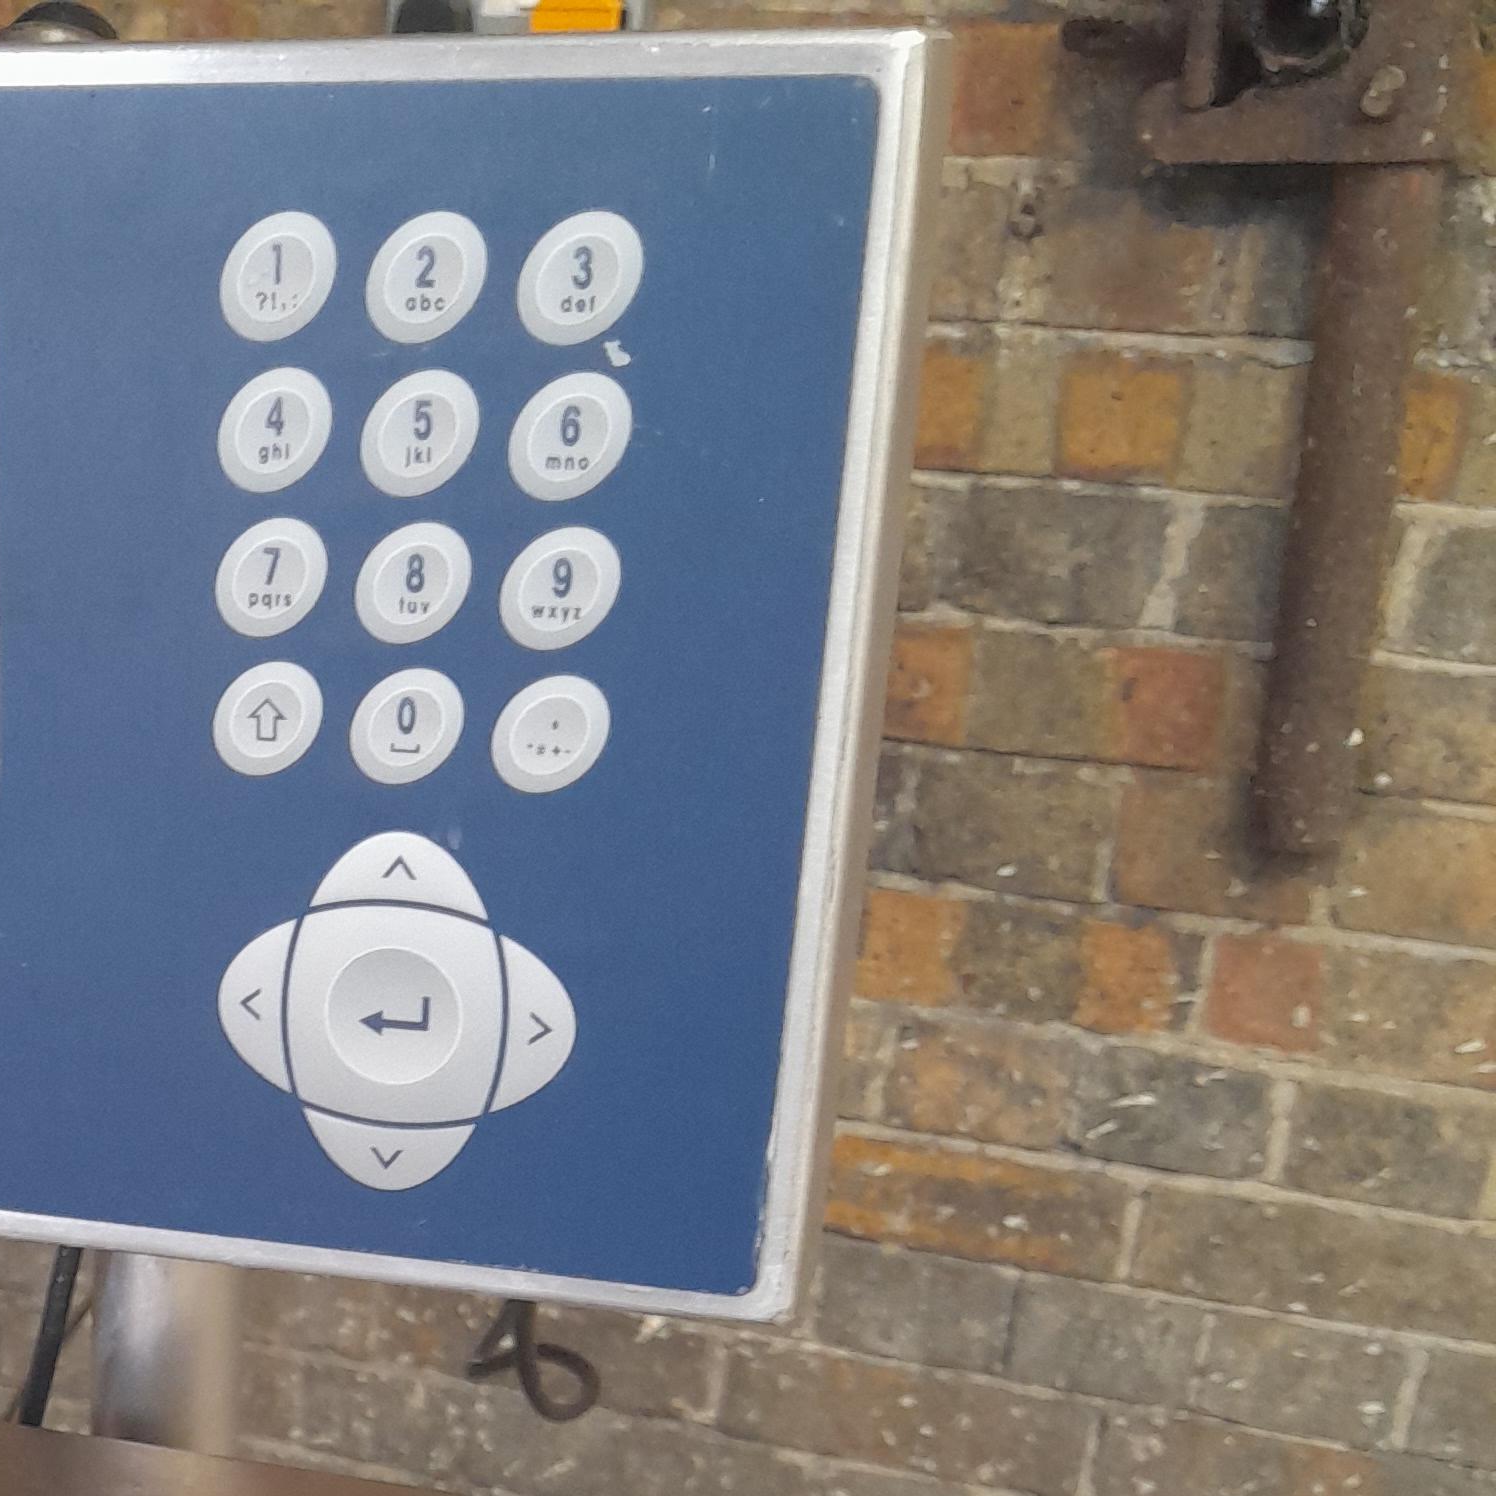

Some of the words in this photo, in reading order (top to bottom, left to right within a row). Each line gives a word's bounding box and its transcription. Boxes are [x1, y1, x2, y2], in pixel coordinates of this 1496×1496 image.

[272, 243, 282, 285] 1
[415, 245, 436, 288] 2
[572, 245, 593, 290] 3
[405, 295, 445, 312] abc
[560, 294, 597, 313] def
[265, 396, 284, 436] 4
[413, 400, 433, 440] 5
[561, 405, 581, 446] 6
[258, 443, 290, 465] ghi
[405, 446, 432, 468] jkl
[545, 456, 590, 471] mno
[263, 547, 280, 585] 7
[406, 554, 425, 593] 8
[552, 557, 573, 598] 9
[248, 591, 292, 609] pqrs
[398, 597, 430, 615] tuv
[531, 603, 582, 625] wxyz
[397, 697, 416, 734] 0
